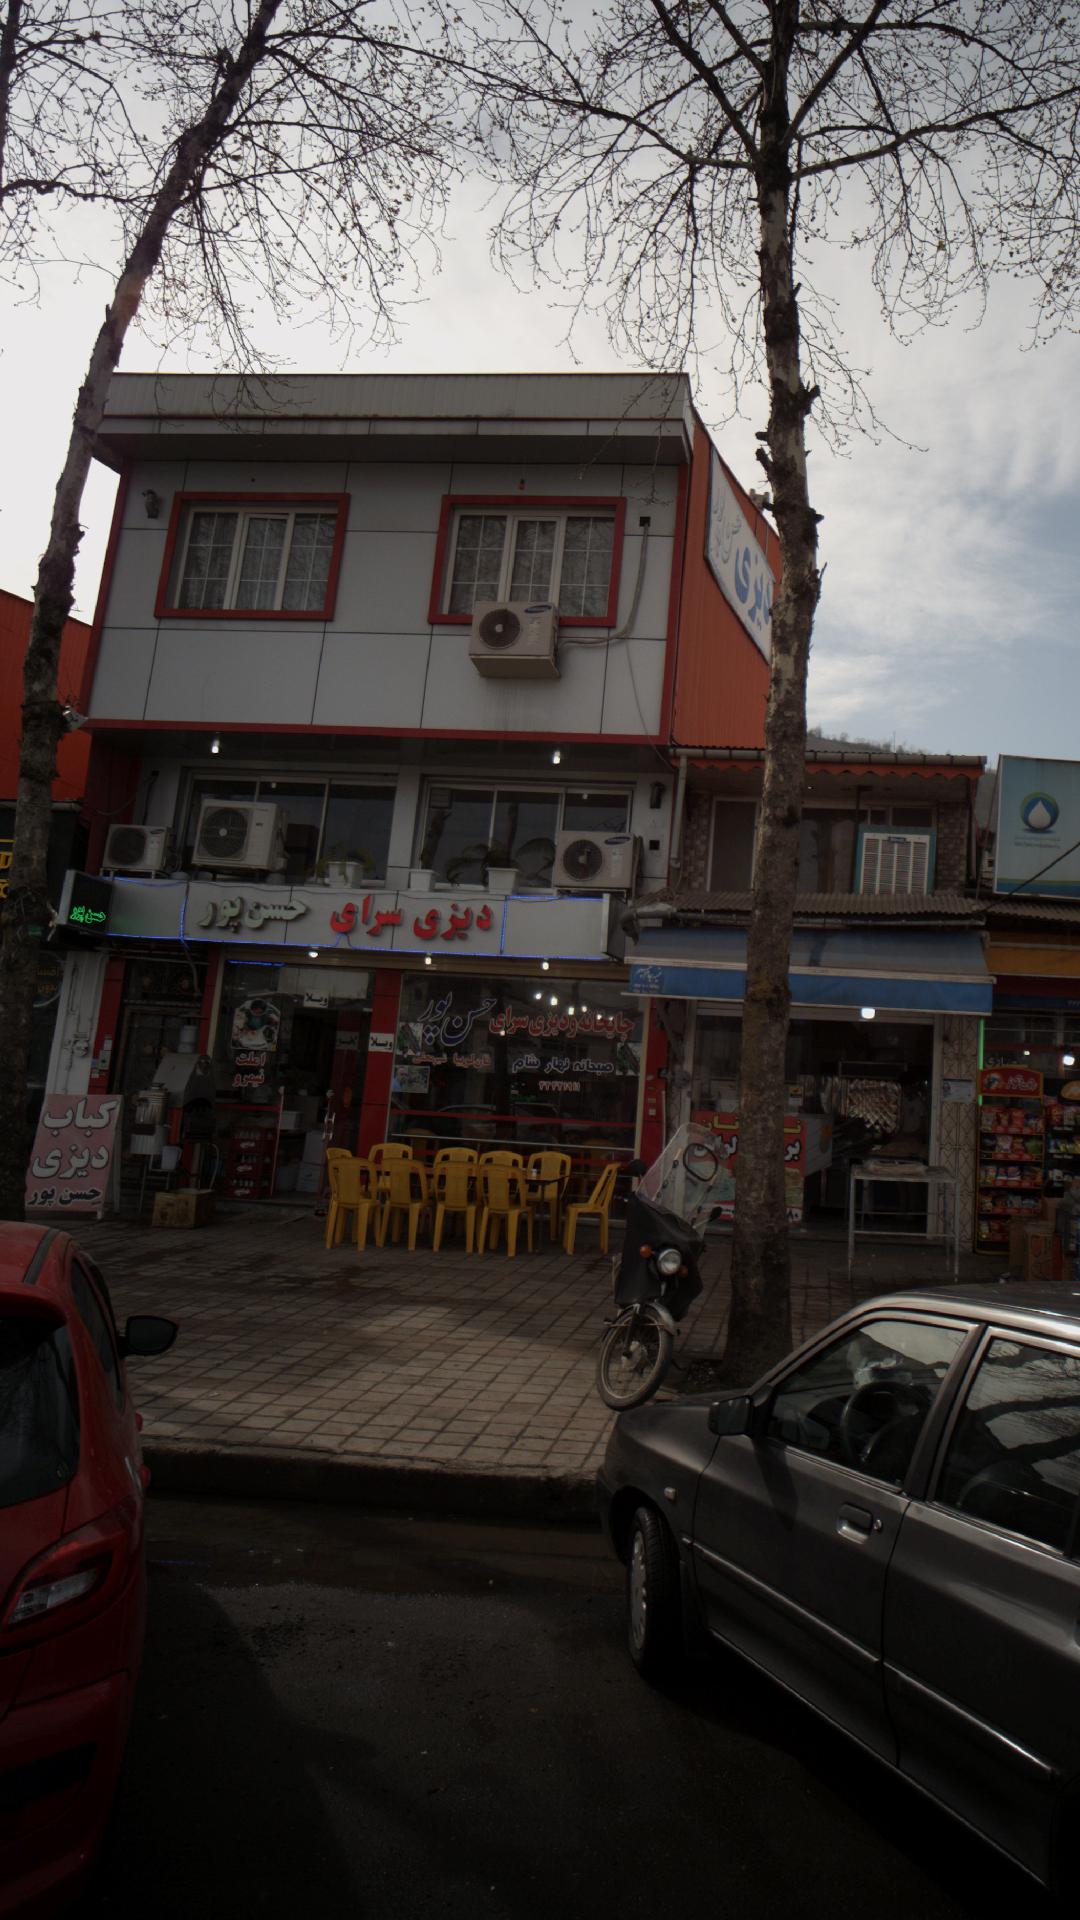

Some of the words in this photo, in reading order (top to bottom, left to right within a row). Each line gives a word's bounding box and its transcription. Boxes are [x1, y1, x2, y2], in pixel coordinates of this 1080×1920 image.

[199, 896, 244, 934] پور
[245, 899, 308, 929] حسن
[330, 894, 402, 936] سرای
[413, 902, 493, 940] دیزی
[488, 1005, 530, 1035] سرای
[528, 1012, 569, 1037] دیزی
[577, 1009, 636, 1040] چایخانه
[511, 1053, 541, 1074] شام
[544, 1055, 571, 1074] نهار
[572, 1058, 615, 1075] صبحانه
[43, 1097, 120, 1137] کباب
[32, 1143, 110, 1180] دیزی
[26, 1186, 56, 1207] پور
[58, 1187, 102, 1206] حسن
